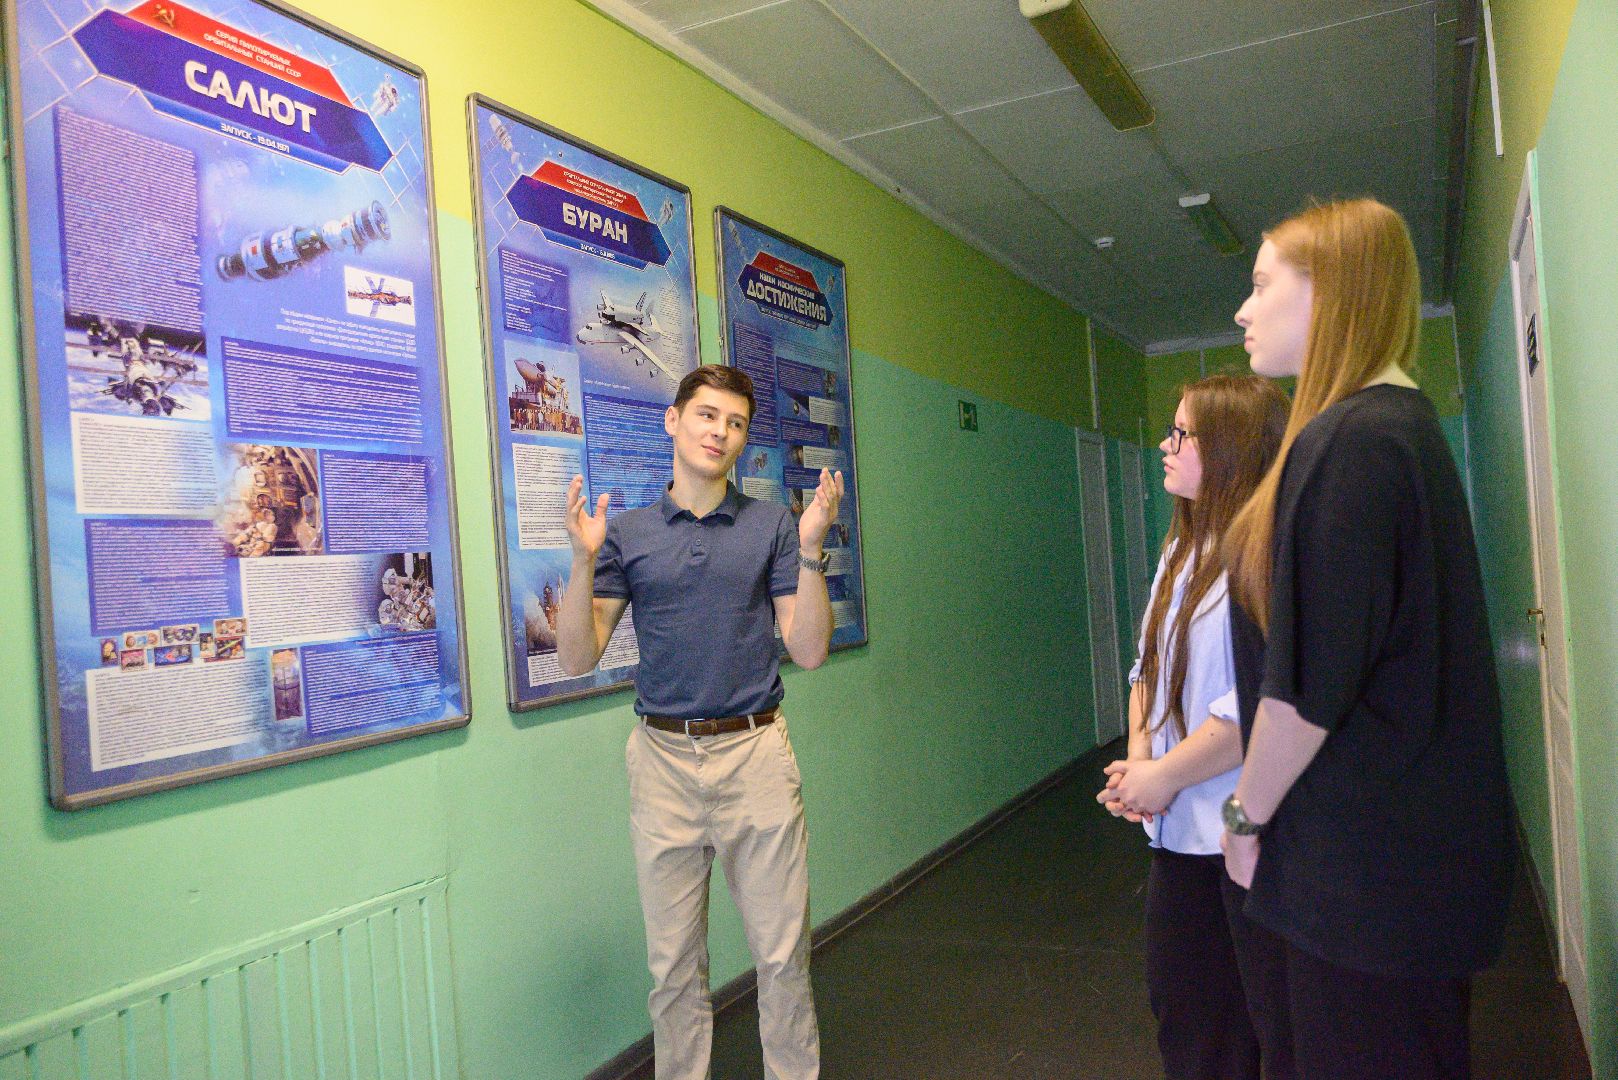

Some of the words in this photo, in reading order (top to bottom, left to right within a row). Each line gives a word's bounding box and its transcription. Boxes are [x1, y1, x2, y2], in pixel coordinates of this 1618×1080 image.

[215, 30, 239, 44] СЕРИЯ
[184, 59, 317, 133] САЛЮТ
[220, 123, 252, 141] ЗАПУСК
[562, 202, 628, 244] БУРАН
[746, 278, 827, 321] ДОСТИЖЕНИЯ
